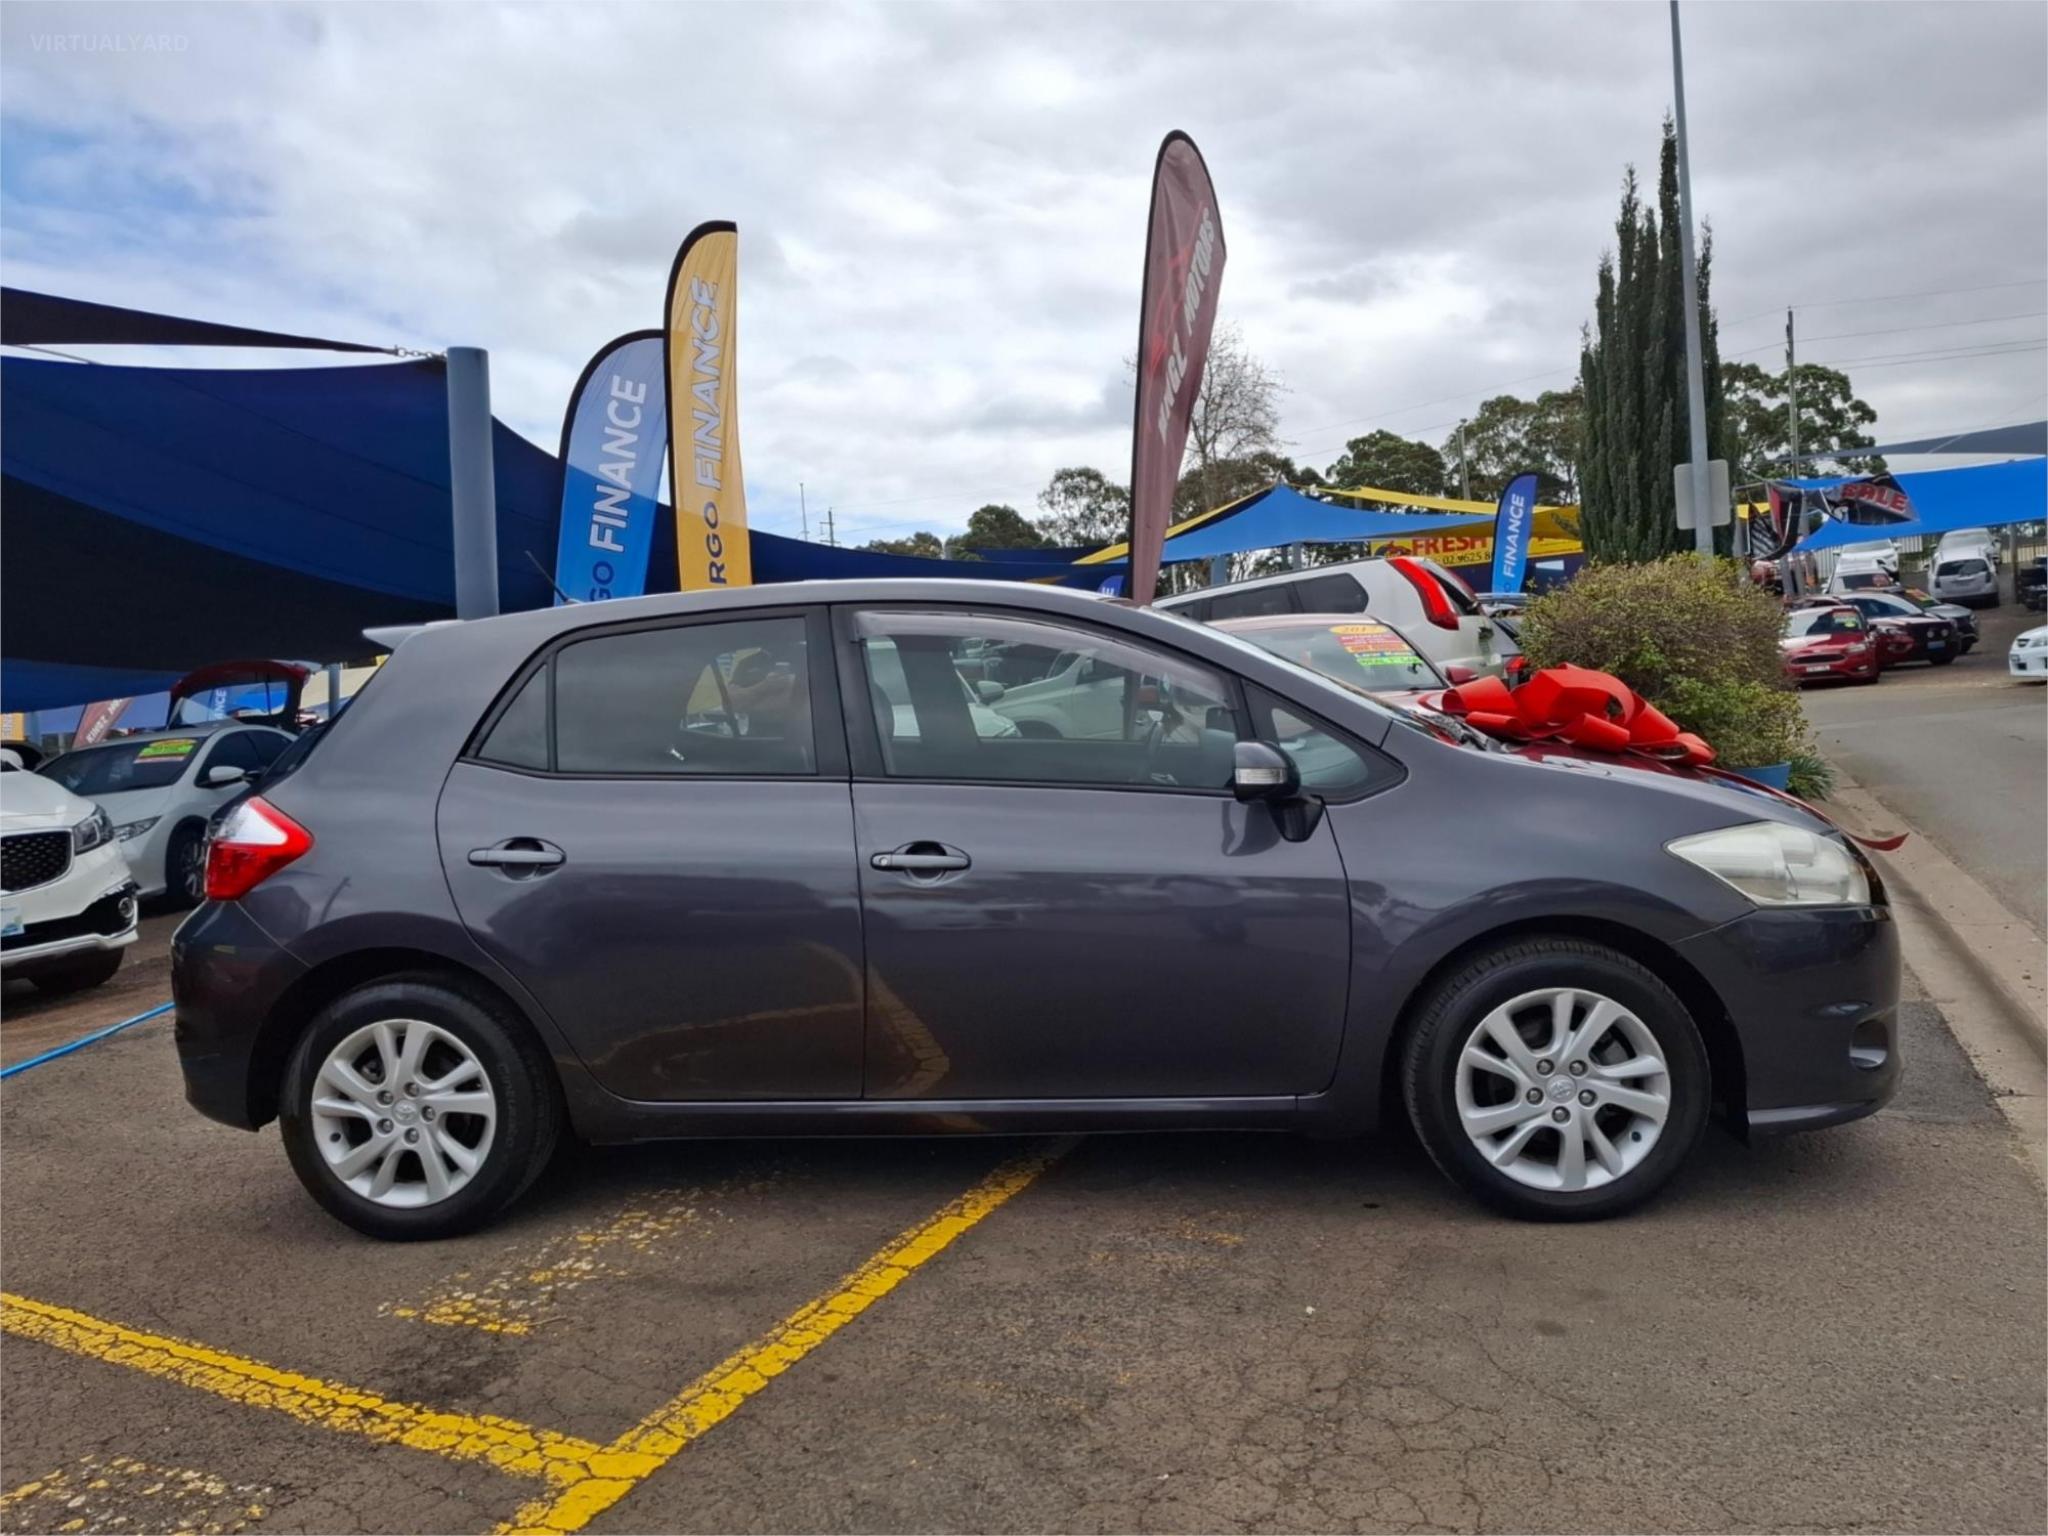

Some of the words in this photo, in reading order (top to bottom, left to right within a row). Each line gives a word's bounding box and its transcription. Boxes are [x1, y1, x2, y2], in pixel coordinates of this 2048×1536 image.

[690, 274, 723, 491] FINANCE
[588, 374, 648, 553] FINANCE
[1840, 483, 1907, 513] SALE
[1411, 536, 1489, 556] FRESH
[1502, 493, 1525, 579] FINANCE
